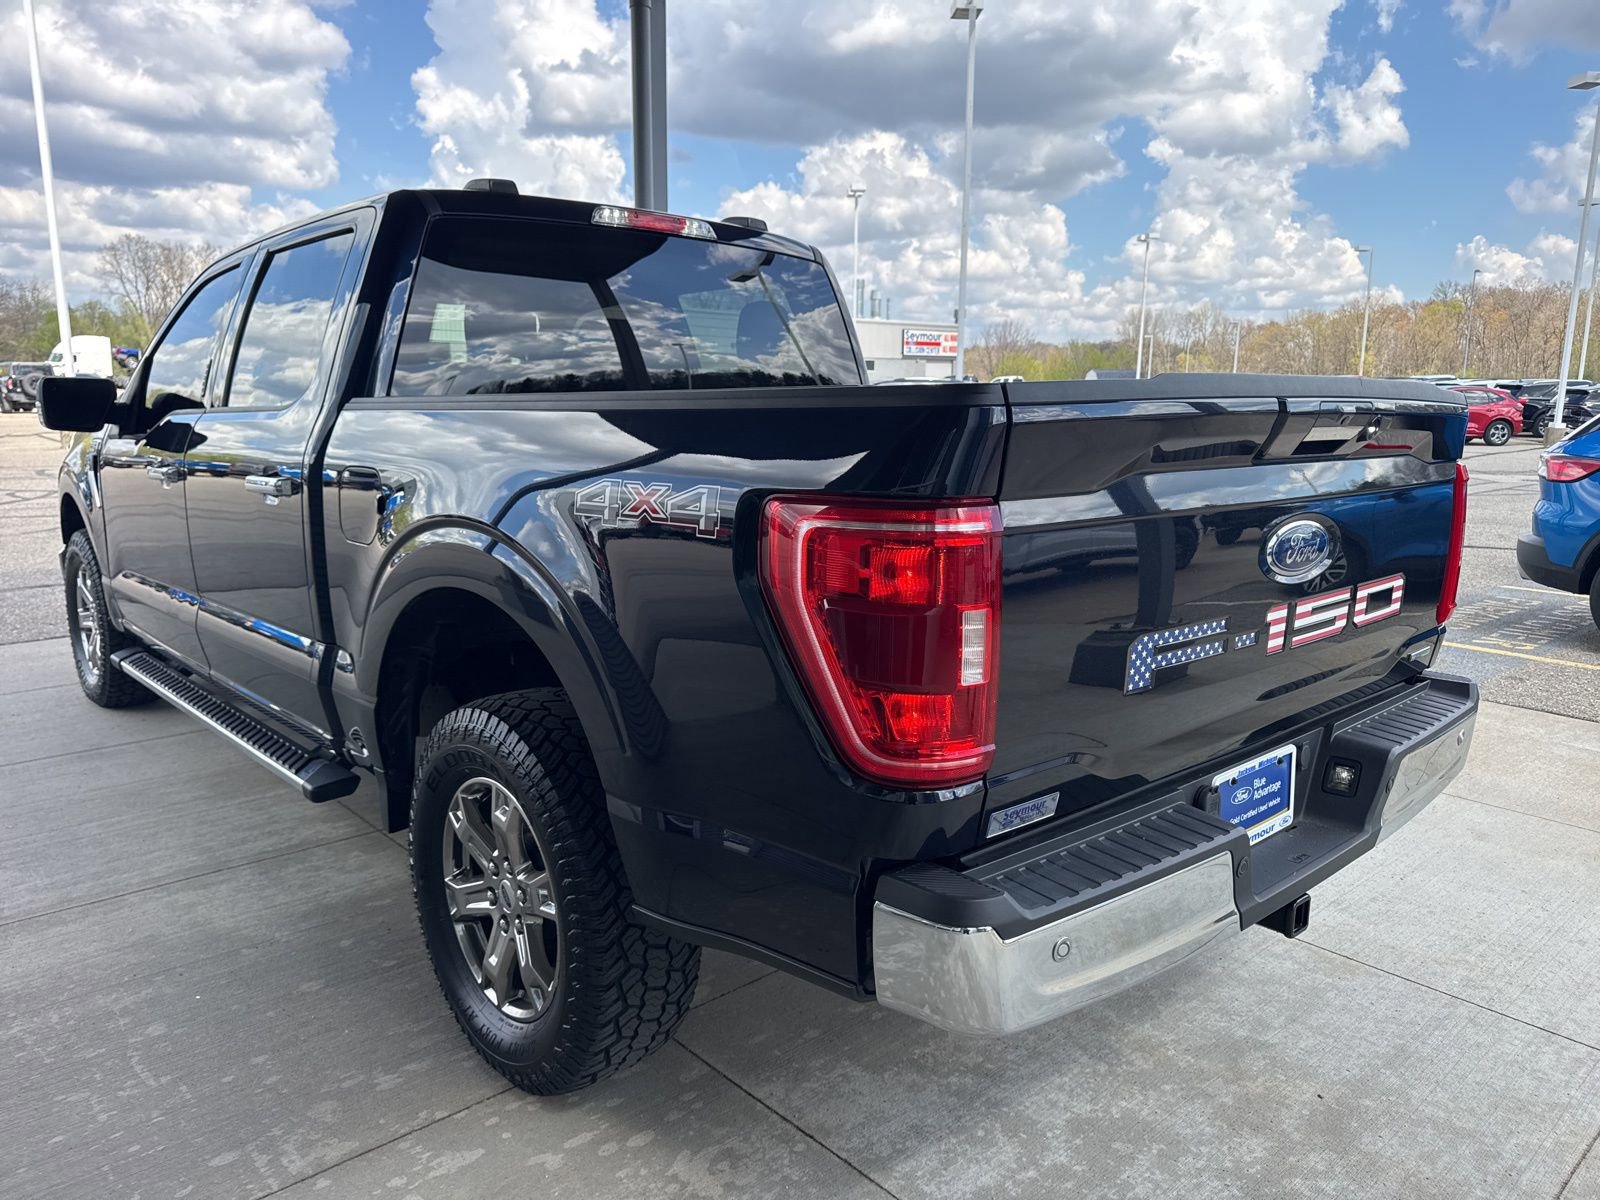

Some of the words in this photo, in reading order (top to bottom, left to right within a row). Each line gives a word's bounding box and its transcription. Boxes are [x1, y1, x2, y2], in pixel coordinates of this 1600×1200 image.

[905, 330, 942, 341] Seymour
[1285, 533, 1321, 564] Ford
[1122, 572, 1406, 696] F-150
[1254, 777, 1266, 789] Blue
[1254, 781, 1281, 800] Advantage
[1234, 789, 1249, 803] Ford
[1003, 800, 1047, 820] Seymour
[1241, 808, 1257, 821] Certified
[1258, 804, 1267, 813] Used
[1269, 797, 1280, 808] Vehicle
[1250, 824, 1276, 842] mour
